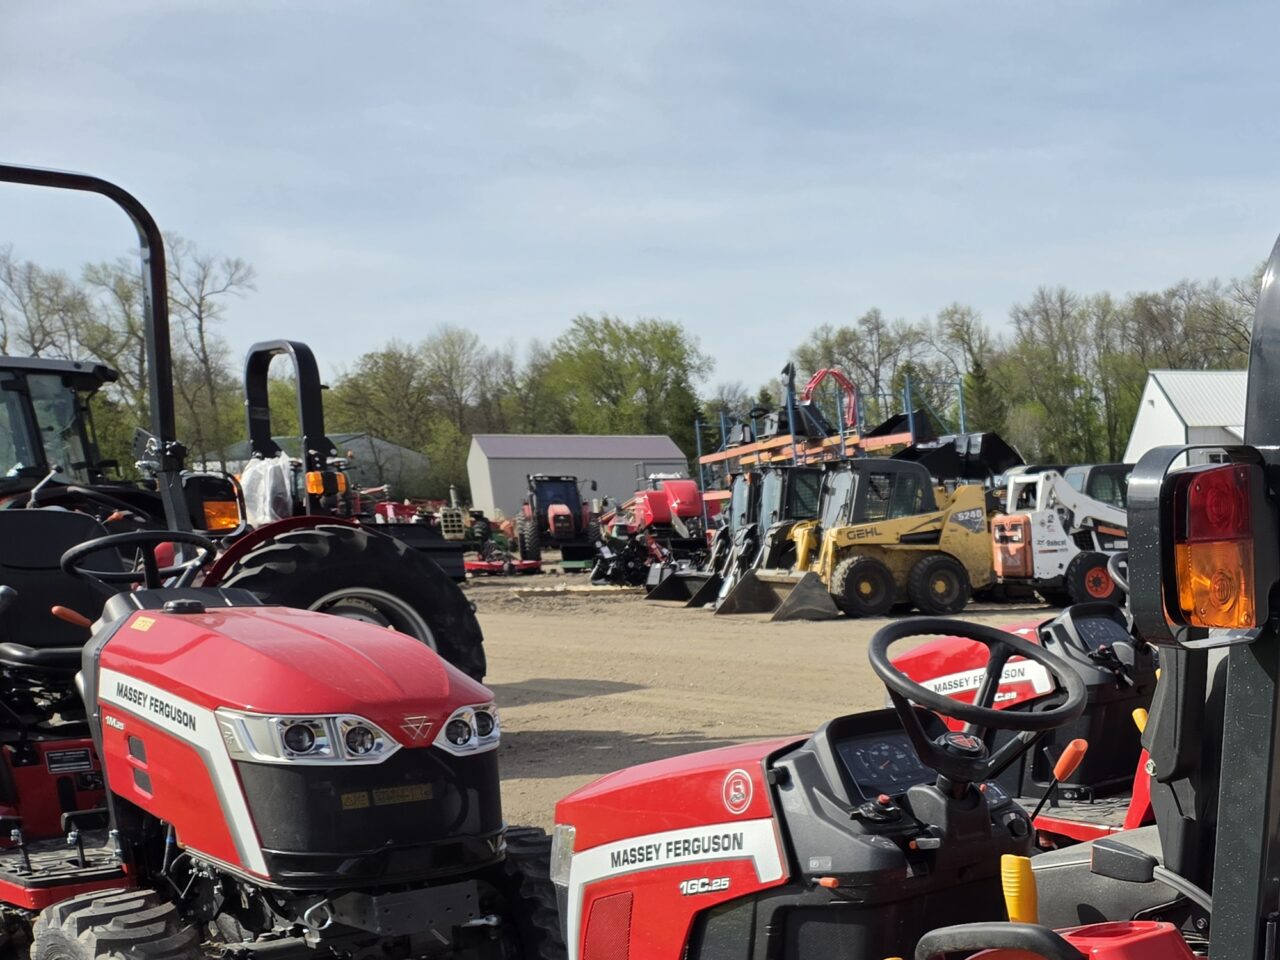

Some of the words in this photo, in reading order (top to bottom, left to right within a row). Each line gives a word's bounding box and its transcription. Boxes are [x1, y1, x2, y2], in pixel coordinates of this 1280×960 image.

[846, 527, 883, 541] GEHL
[934, 676, 971, 693] MASSEY
[973, 667, 1026, 685] FESON
[116, 681, 149, 708] MASSEY
[149, 696, 197, 731] FERGUSON
[610, 843, 662, 868] MASSEY
[666, 832, 744, 859] FERGUSON
